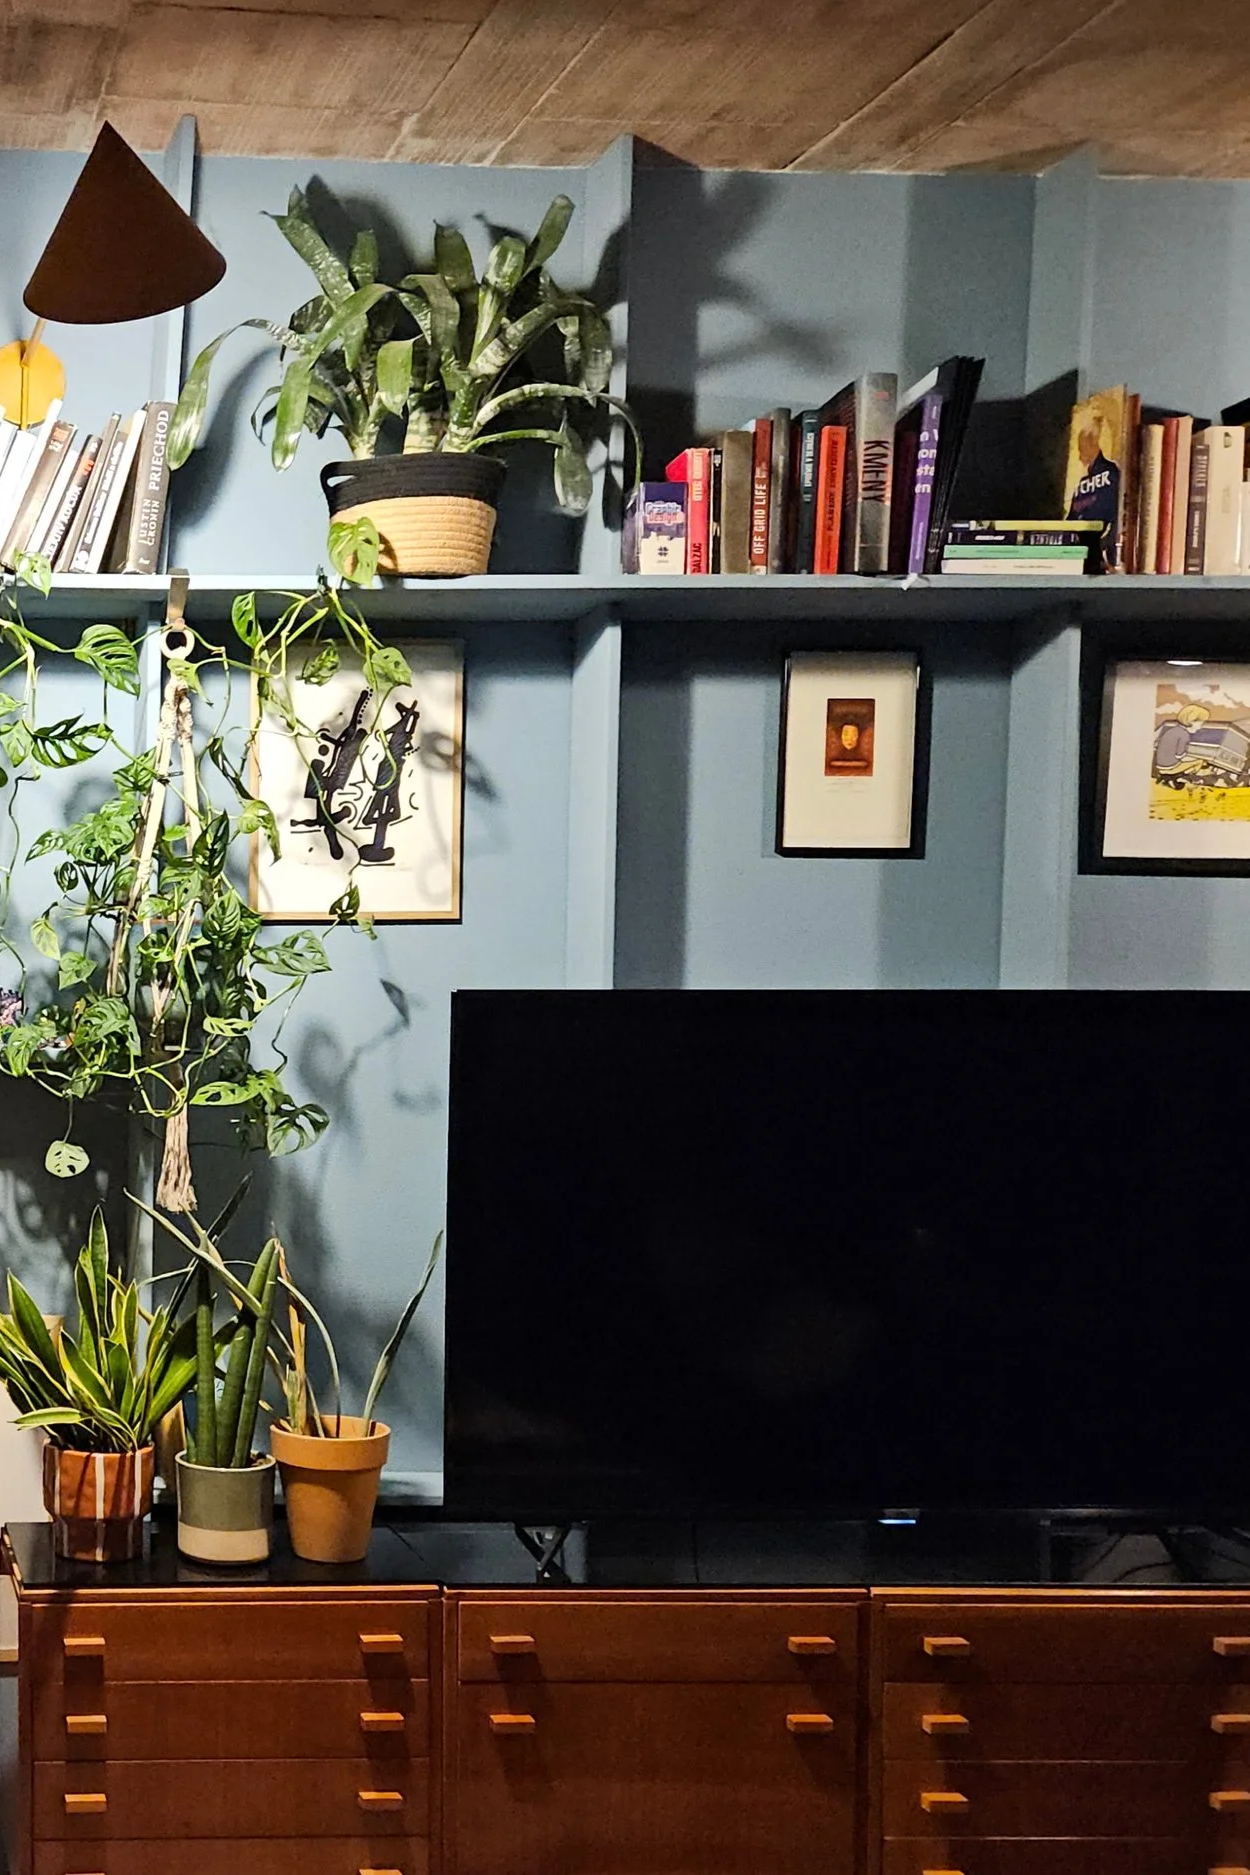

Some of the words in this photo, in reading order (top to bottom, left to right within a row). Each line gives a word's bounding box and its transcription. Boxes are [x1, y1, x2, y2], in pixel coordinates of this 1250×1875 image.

[149, 410, 169, 491] PRIECHOD
[862, 440, 889, 503] KMENY
[754, 483, 766, 505] LIFE
[138, 498, 152, 545] JUSTIN
[147, 501, 160, 546] CRONIN
[753, 509, 766, 532] GRID
[752, 535, 765, 554] OFF
